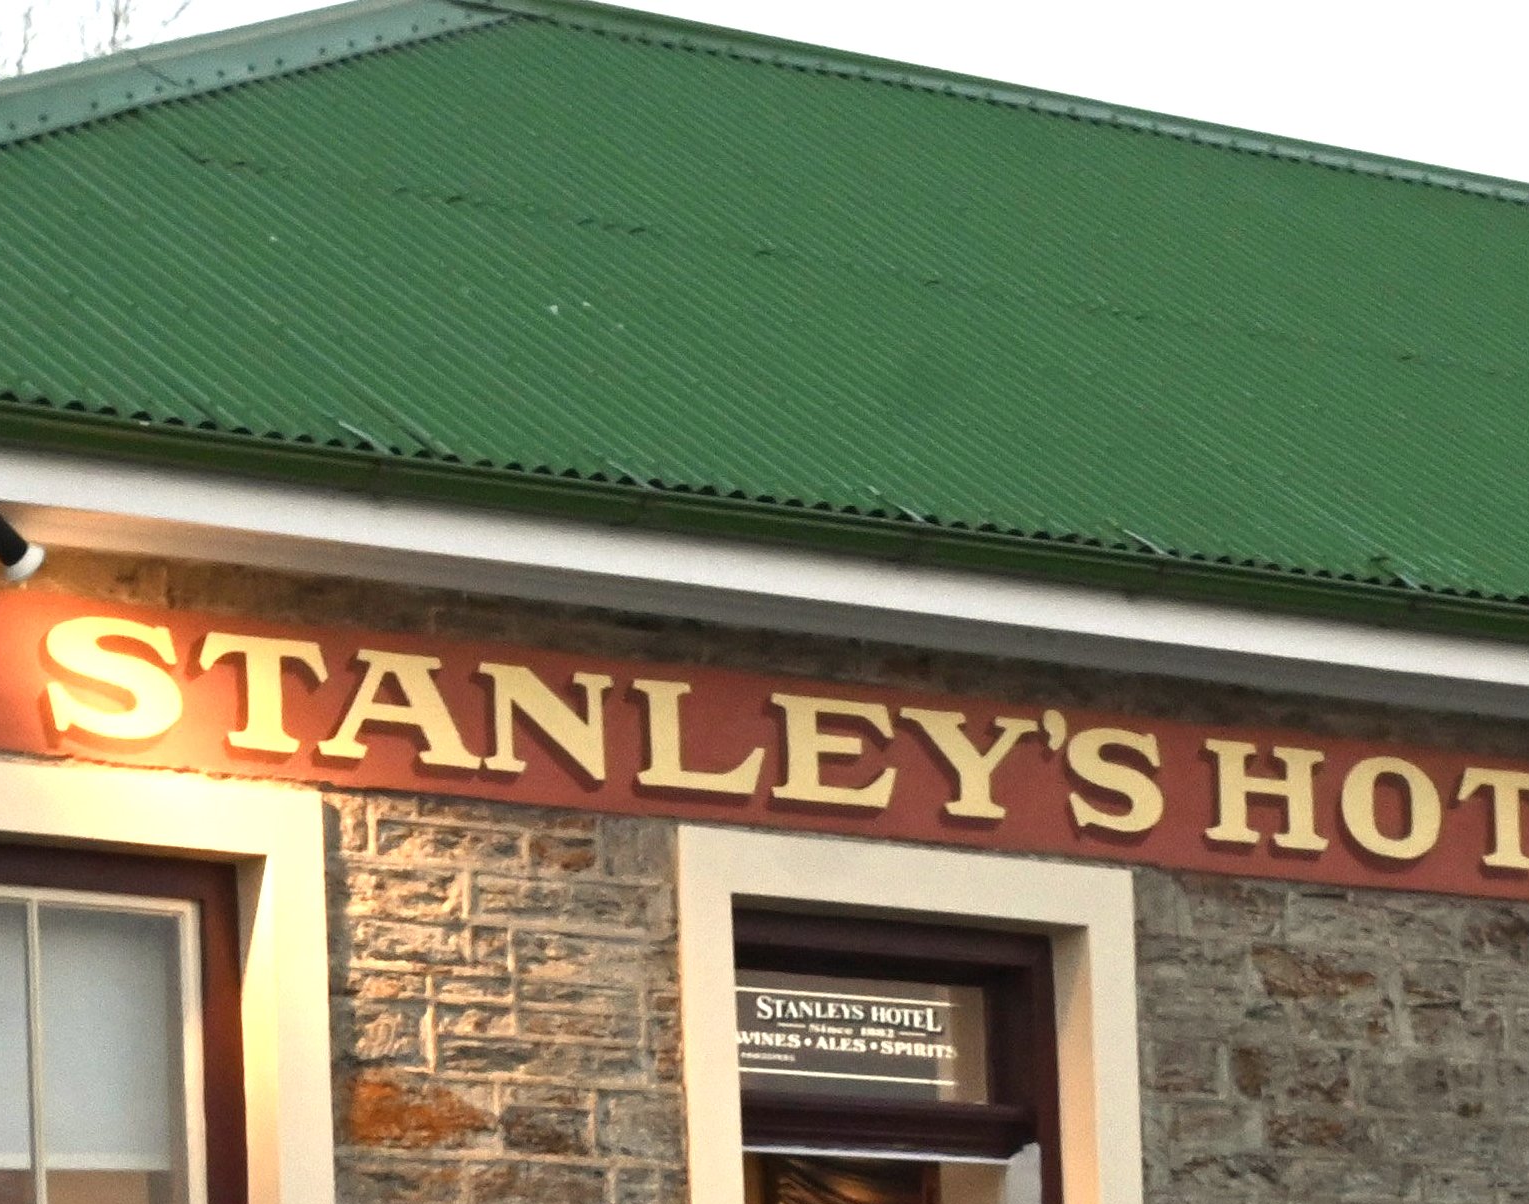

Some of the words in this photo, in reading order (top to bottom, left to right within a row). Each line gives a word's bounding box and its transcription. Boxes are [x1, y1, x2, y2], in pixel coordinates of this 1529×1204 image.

[45, 615, 1162, 832] STANLEY'S
[871, 1005, 942, 1033] HOTEL
[736, 1030, 801, 1049] WINES
[815, 1036, 866, 1053] ALES
[880, 1040, 958, 1059] SPIRITS
